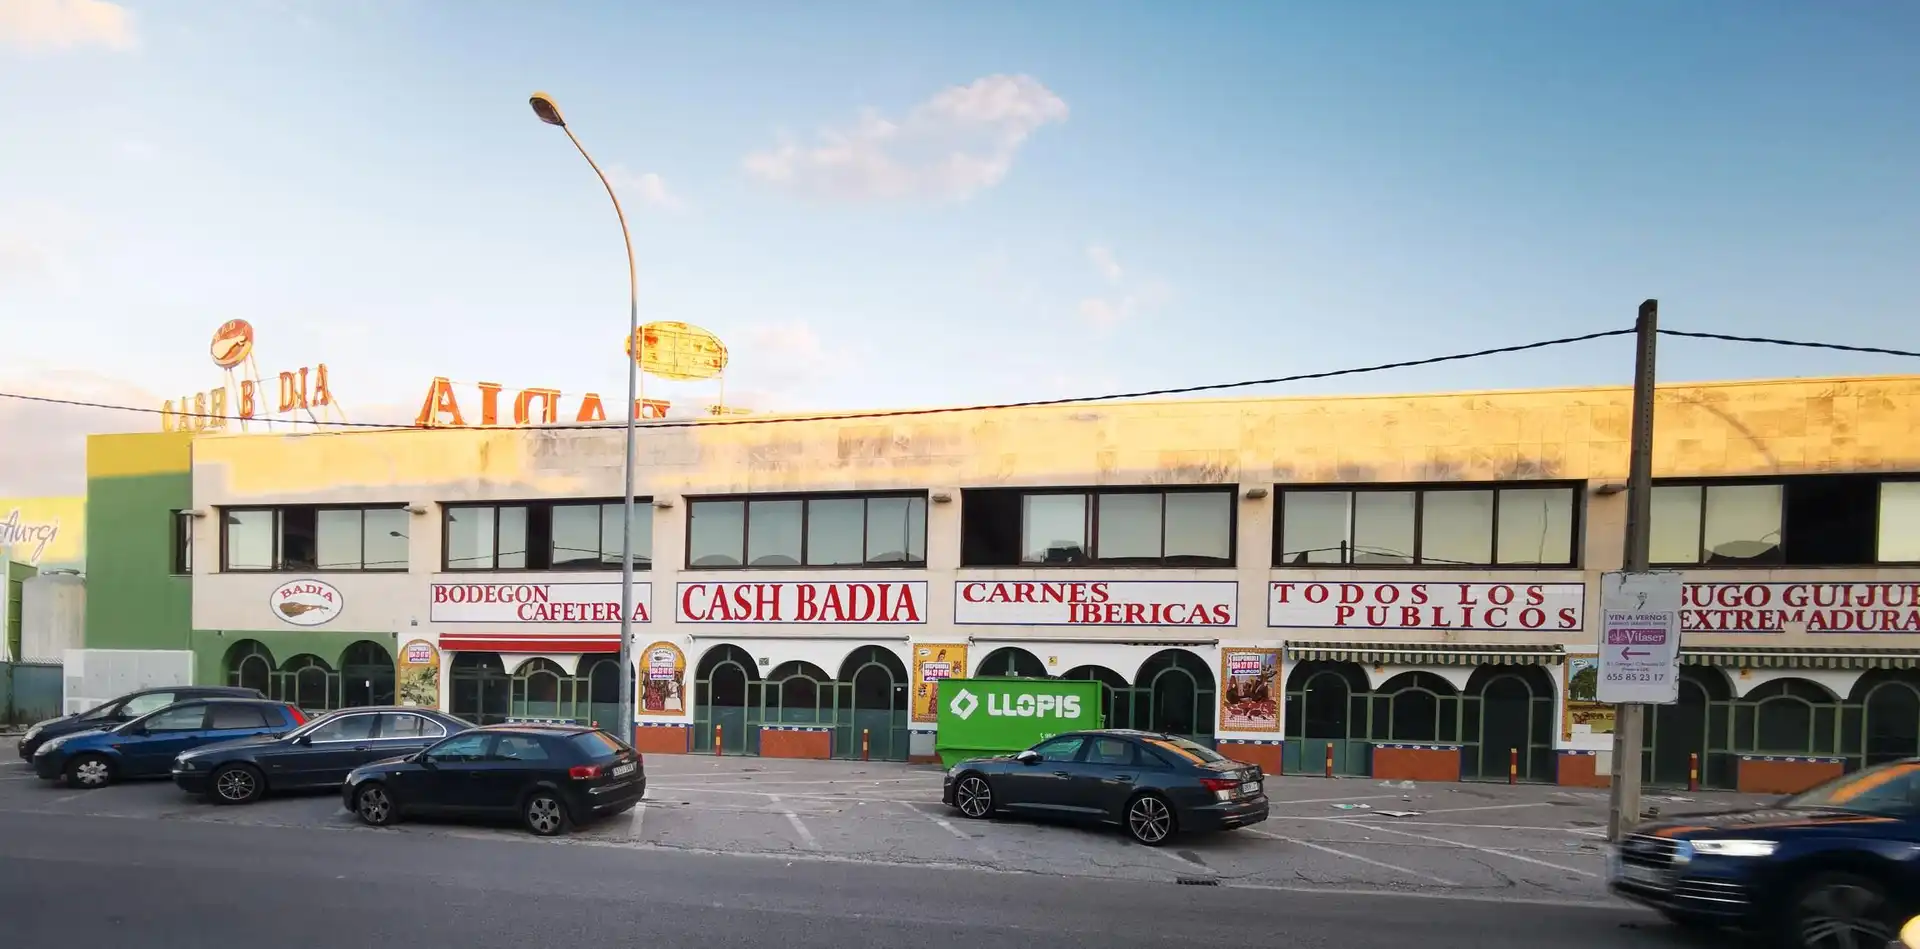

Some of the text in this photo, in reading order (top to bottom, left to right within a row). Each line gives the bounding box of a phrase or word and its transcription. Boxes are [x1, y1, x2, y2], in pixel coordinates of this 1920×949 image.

[161, 386, 228, 433] CASH
[280, 584, 333, 603] BADIA
[434, 584, 550, 604] BODEGON
[682, 584, 920, 622] CASH BADIA
[962, 582, 1110, 603] CARNES
[1273, 583, 1546, 606] TODOS LOS
[516, 602, 650, 621] CAFETERA
[1067, 602, 1232, 625] IBERICAS
[1334, 605, 1577, 629] PUBLICOS
[1625, 629, 1664, 643] Vilaser
[1606, 673, 1665, 681] 655 85 23 17
[988, 693, 1081, 719] LLOPIS
